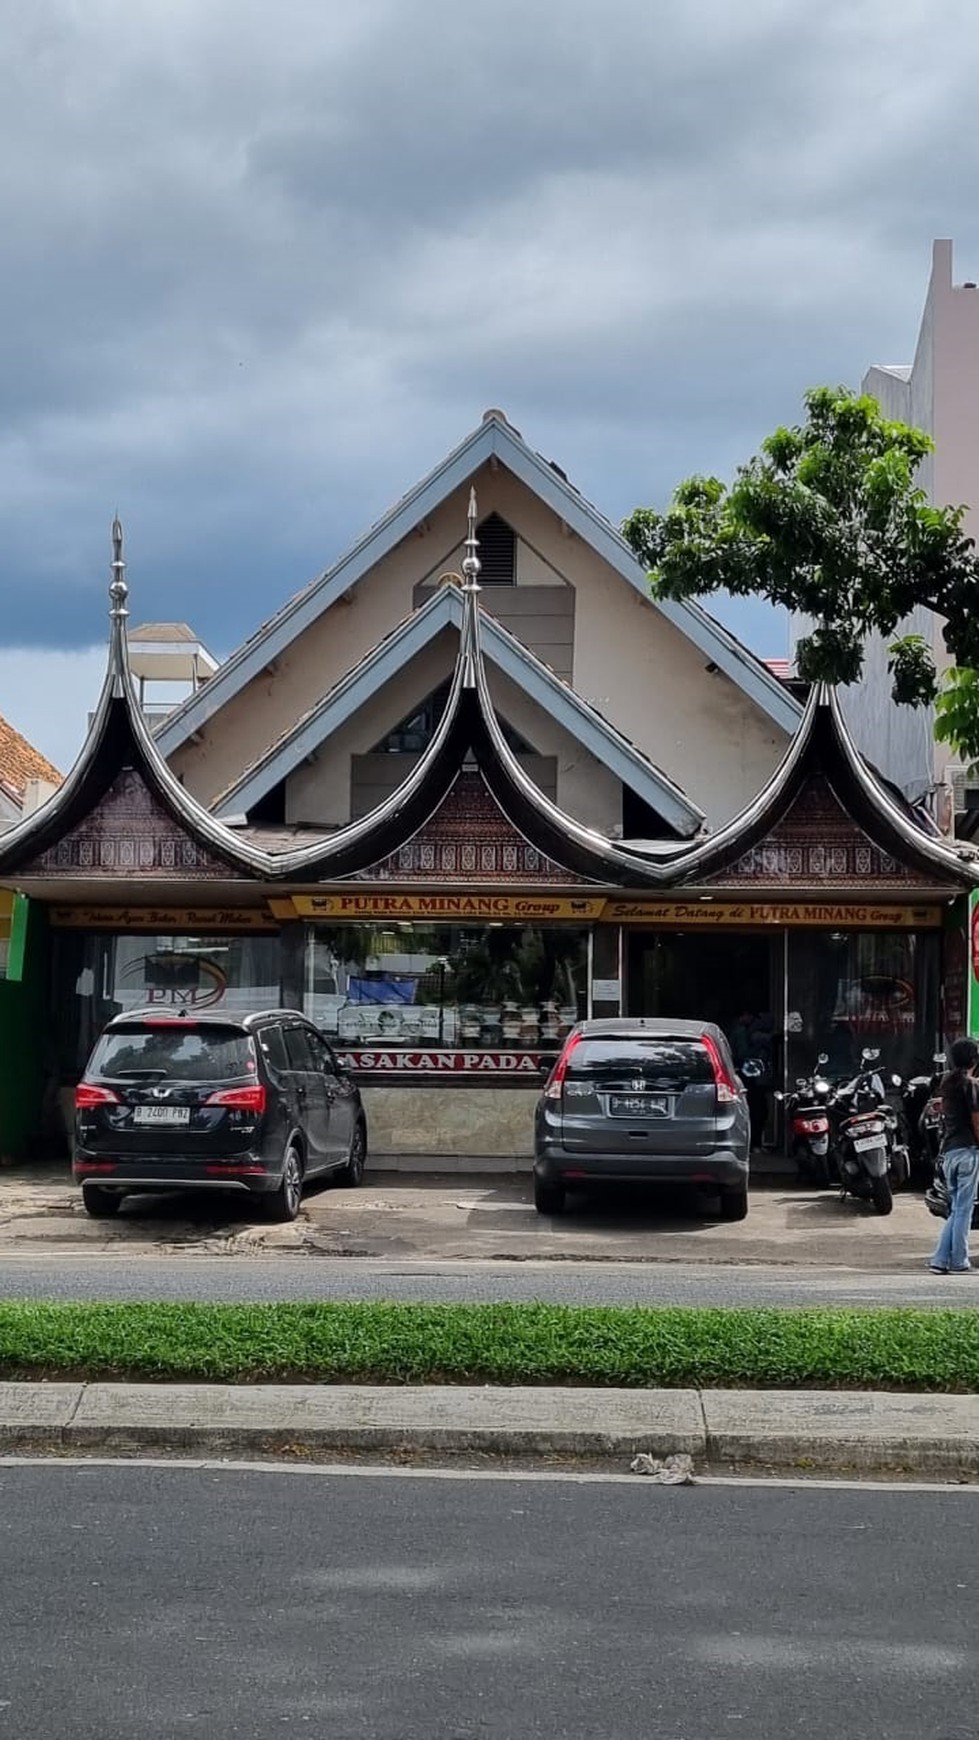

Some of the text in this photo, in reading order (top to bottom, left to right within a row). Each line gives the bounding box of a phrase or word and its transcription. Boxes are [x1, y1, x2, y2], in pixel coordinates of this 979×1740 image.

[341, 897, 414, 910] PUTRA
[418, 897, 509, 911] MINANG
[515, 900, 560, 914] Group
[612, 905, 903, 923] Selamat Datang di PUTRA MINANG Group
[337, 1053, 542, 1071] ASAKAN PADA
